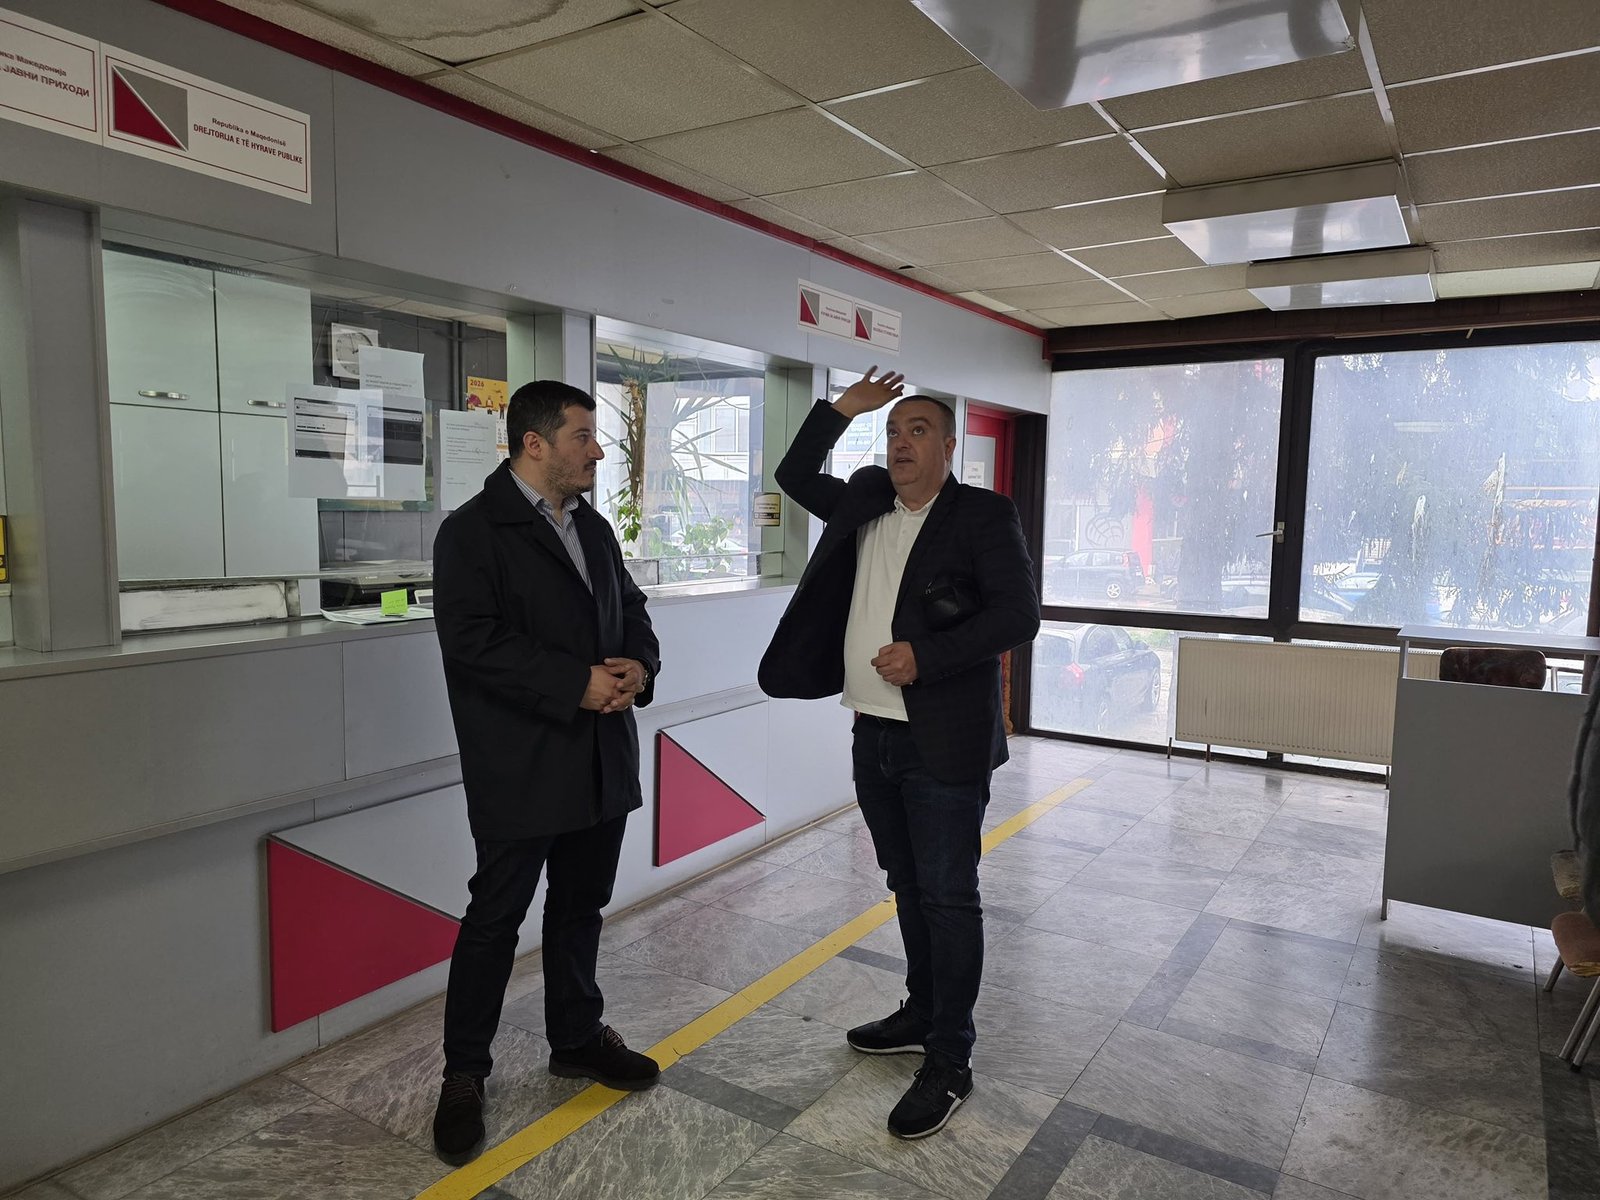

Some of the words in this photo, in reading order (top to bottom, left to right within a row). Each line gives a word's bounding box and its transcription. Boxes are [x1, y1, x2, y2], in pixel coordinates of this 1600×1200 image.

[15, 54, 67, 76] Македонија
[3, 64, 39, 82] ЈАВНИ
[41, 75, 90, 97] ПРИХОДИ
[212, 118, 244, 133] Republika
[193, 124, 234, 142] DREJTORIJA
[236, 137, 240, 145] E
[241, 138, 250, 148] TË
[251, 142, 276, 155] HYRAVE
[278, 151, 302, 164] PUBLIKE
